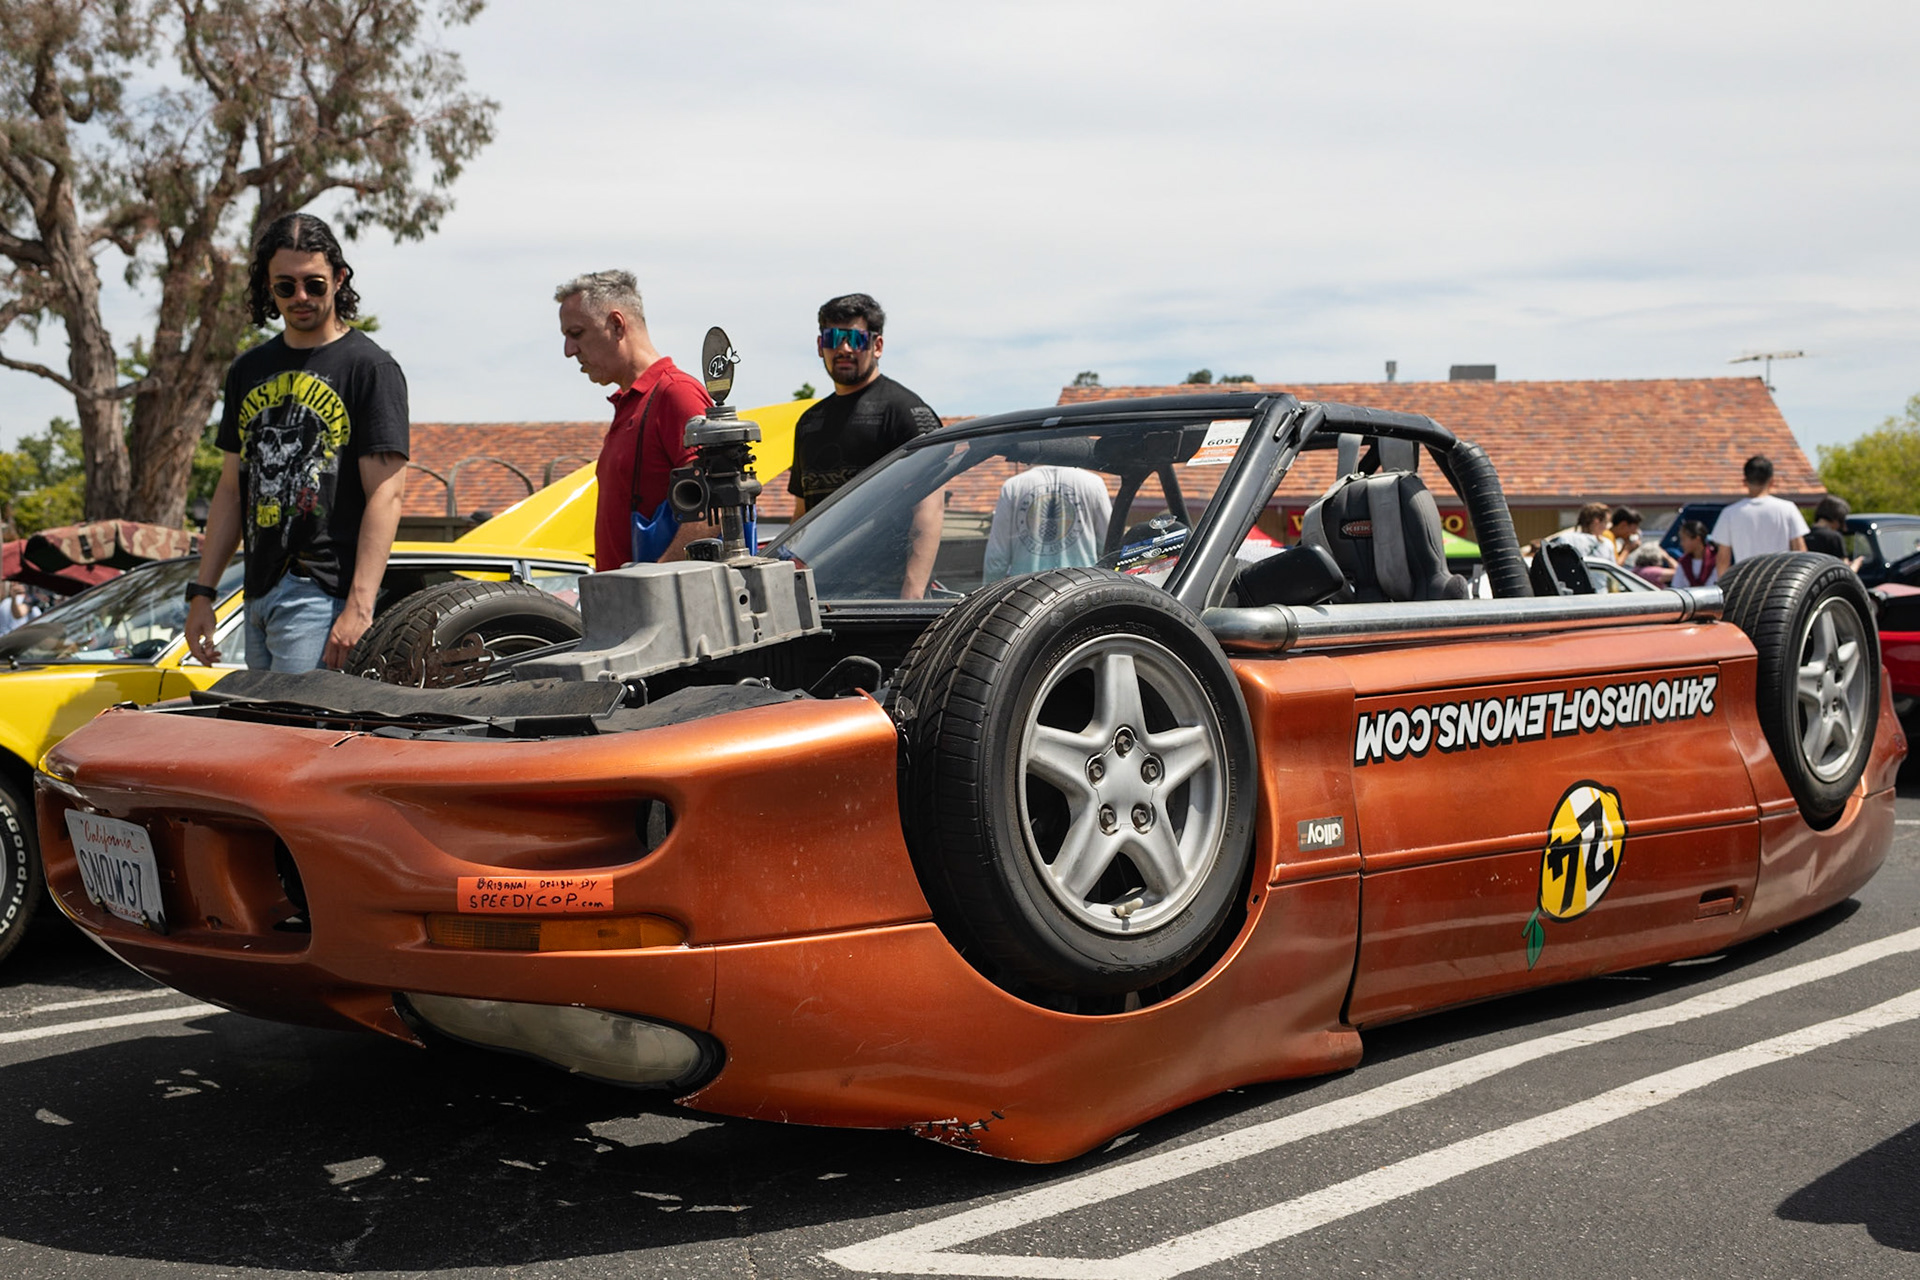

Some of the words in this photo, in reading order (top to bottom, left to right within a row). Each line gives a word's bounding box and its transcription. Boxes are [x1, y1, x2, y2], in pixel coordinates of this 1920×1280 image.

[302, 379, 350, 440] ROSES
[1074, 588, 1196, 628] SUMITOMO
[1354, 675, 1718, 763] 24HOURSOFLEMONS.COM
[84, 820, 139, 853] California
[1307, 822, 1342, 845] alloy
[1546, 796, 1616, 916] 24
[80, 849, 144, 910] SNOW37
[580, 878, 598, 891] BY
